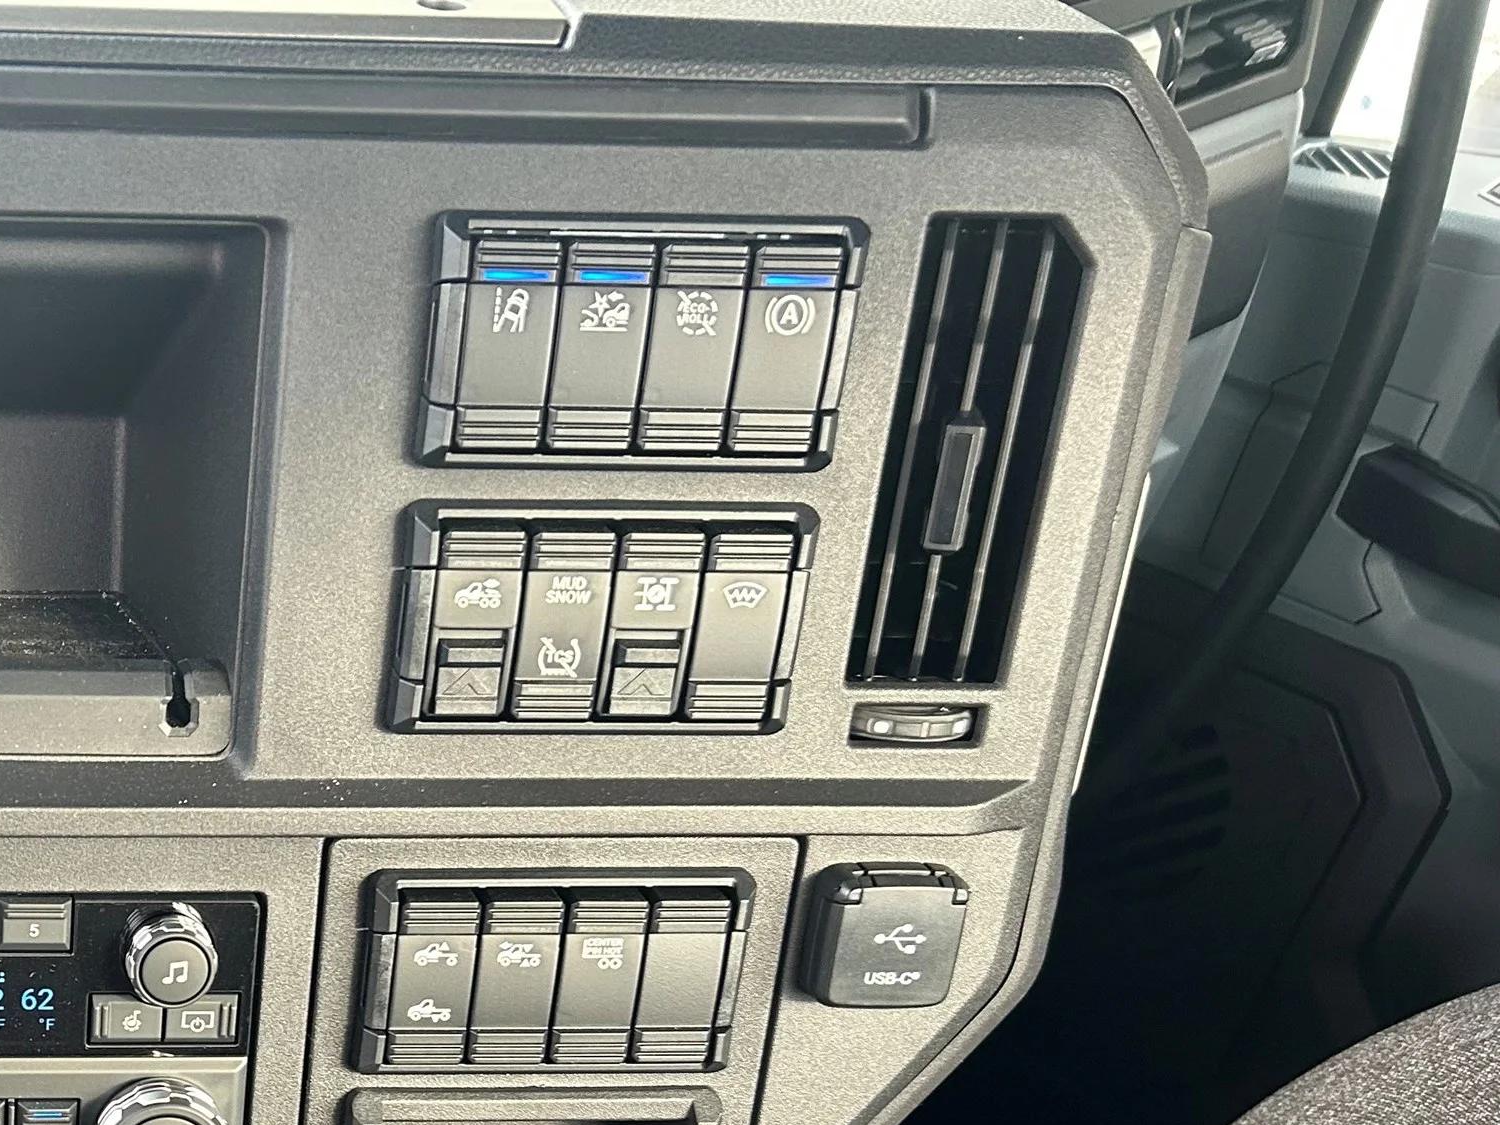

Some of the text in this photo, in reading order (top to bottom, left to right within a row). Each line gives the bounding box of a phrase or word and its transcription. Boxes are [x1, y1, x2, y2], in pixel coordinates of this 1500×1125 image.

[552, 575, 587, 591] MUD
[545, 590, 591, 604] SNOW
[545, 649, 575, 663] TCS
[29, 923, 40, 938] 5
[21, 988, 55, 1011] 62
